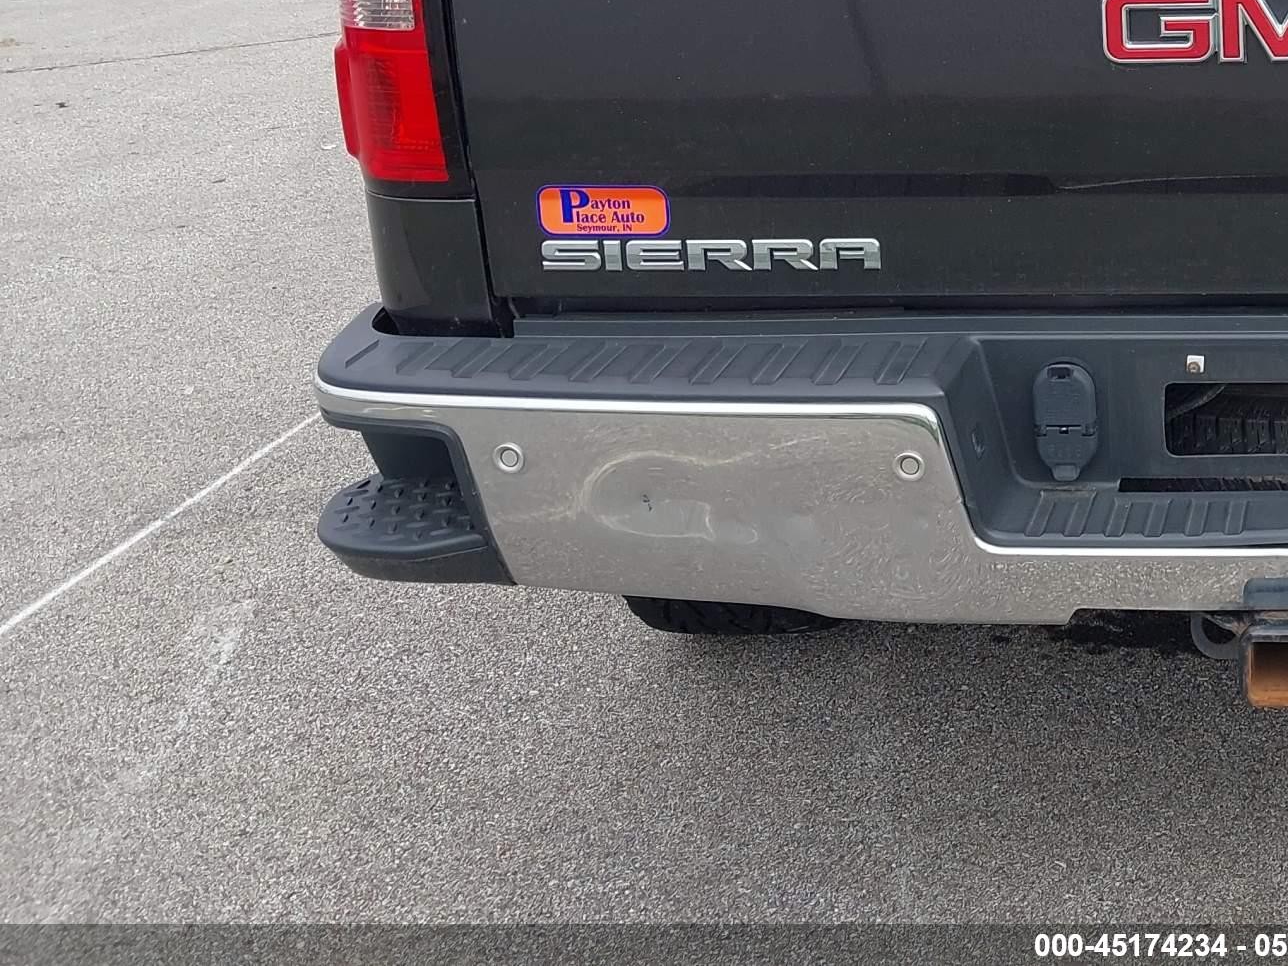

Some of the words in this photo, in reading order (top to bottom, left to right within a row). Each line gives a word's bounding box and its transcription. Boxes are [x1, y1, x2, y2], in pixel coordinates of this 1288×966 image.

[560, 189, 631, 223] Payton
[611, 211, 645, 224] Auto
[576, 224, 620, 234] Seymour,
[622, 224, 633, 232] IN
[541, 237, 881, 271] SIERRA
